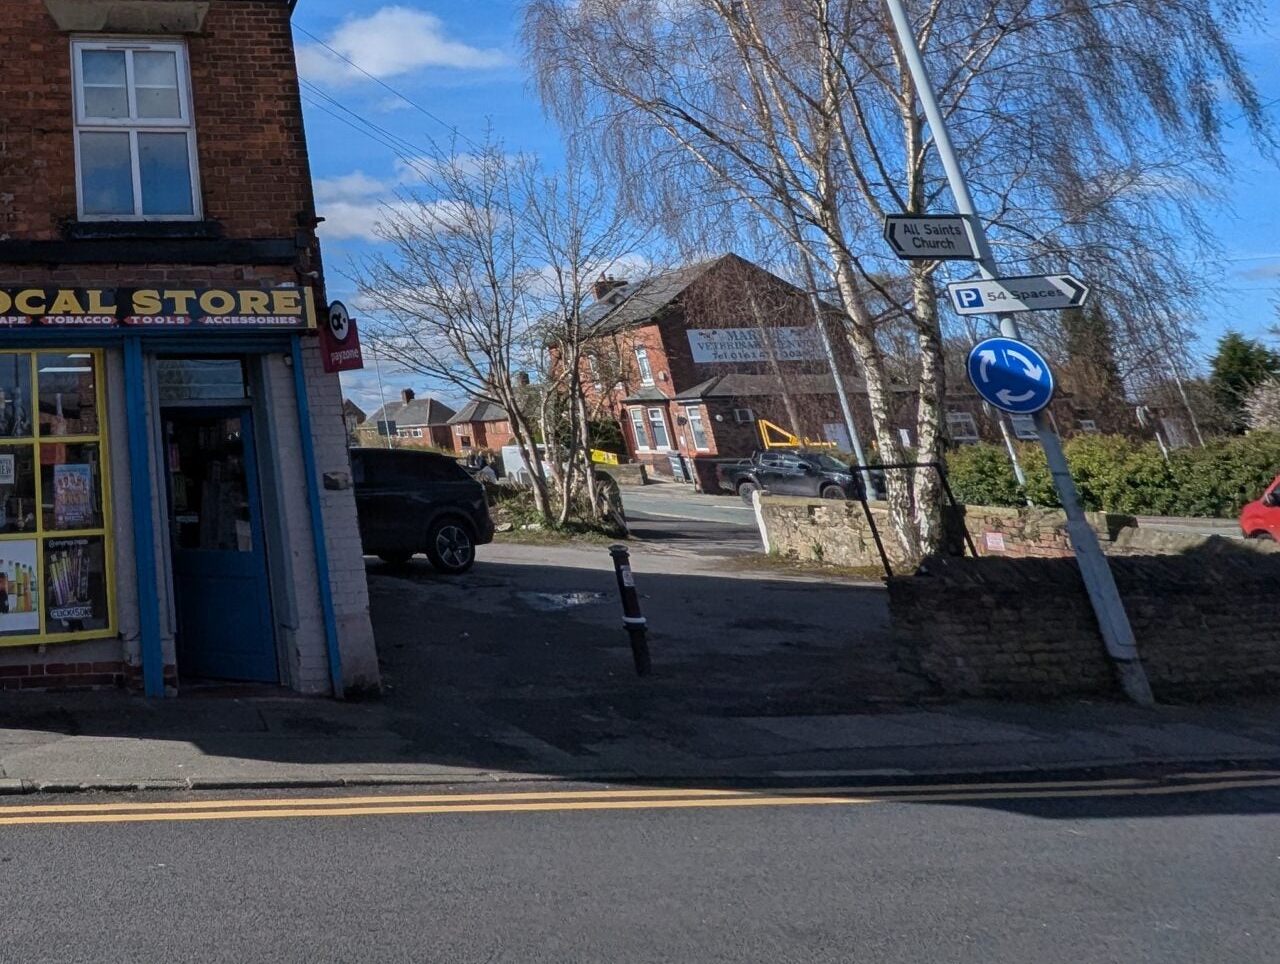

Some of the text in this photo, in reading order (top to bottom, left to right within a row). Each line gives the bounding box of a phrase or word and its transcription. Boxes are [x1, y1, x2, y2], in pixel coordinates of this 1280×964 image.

[903, 223, 962, 236] All Saints
[912, 237, 955, 250] Church
[131, 289, 302, 315] STORE
[959, 288, 1065, 307] P 54 Spaces
[45, 316, 112, 325] TOBACCO
[130, 316, 185, 324] TOOLS
[204, 316, 297, 324] ACCESSORIES
[697, 340, 767, 351] VETERINAR
[330, 349, 359, 364] payzone
